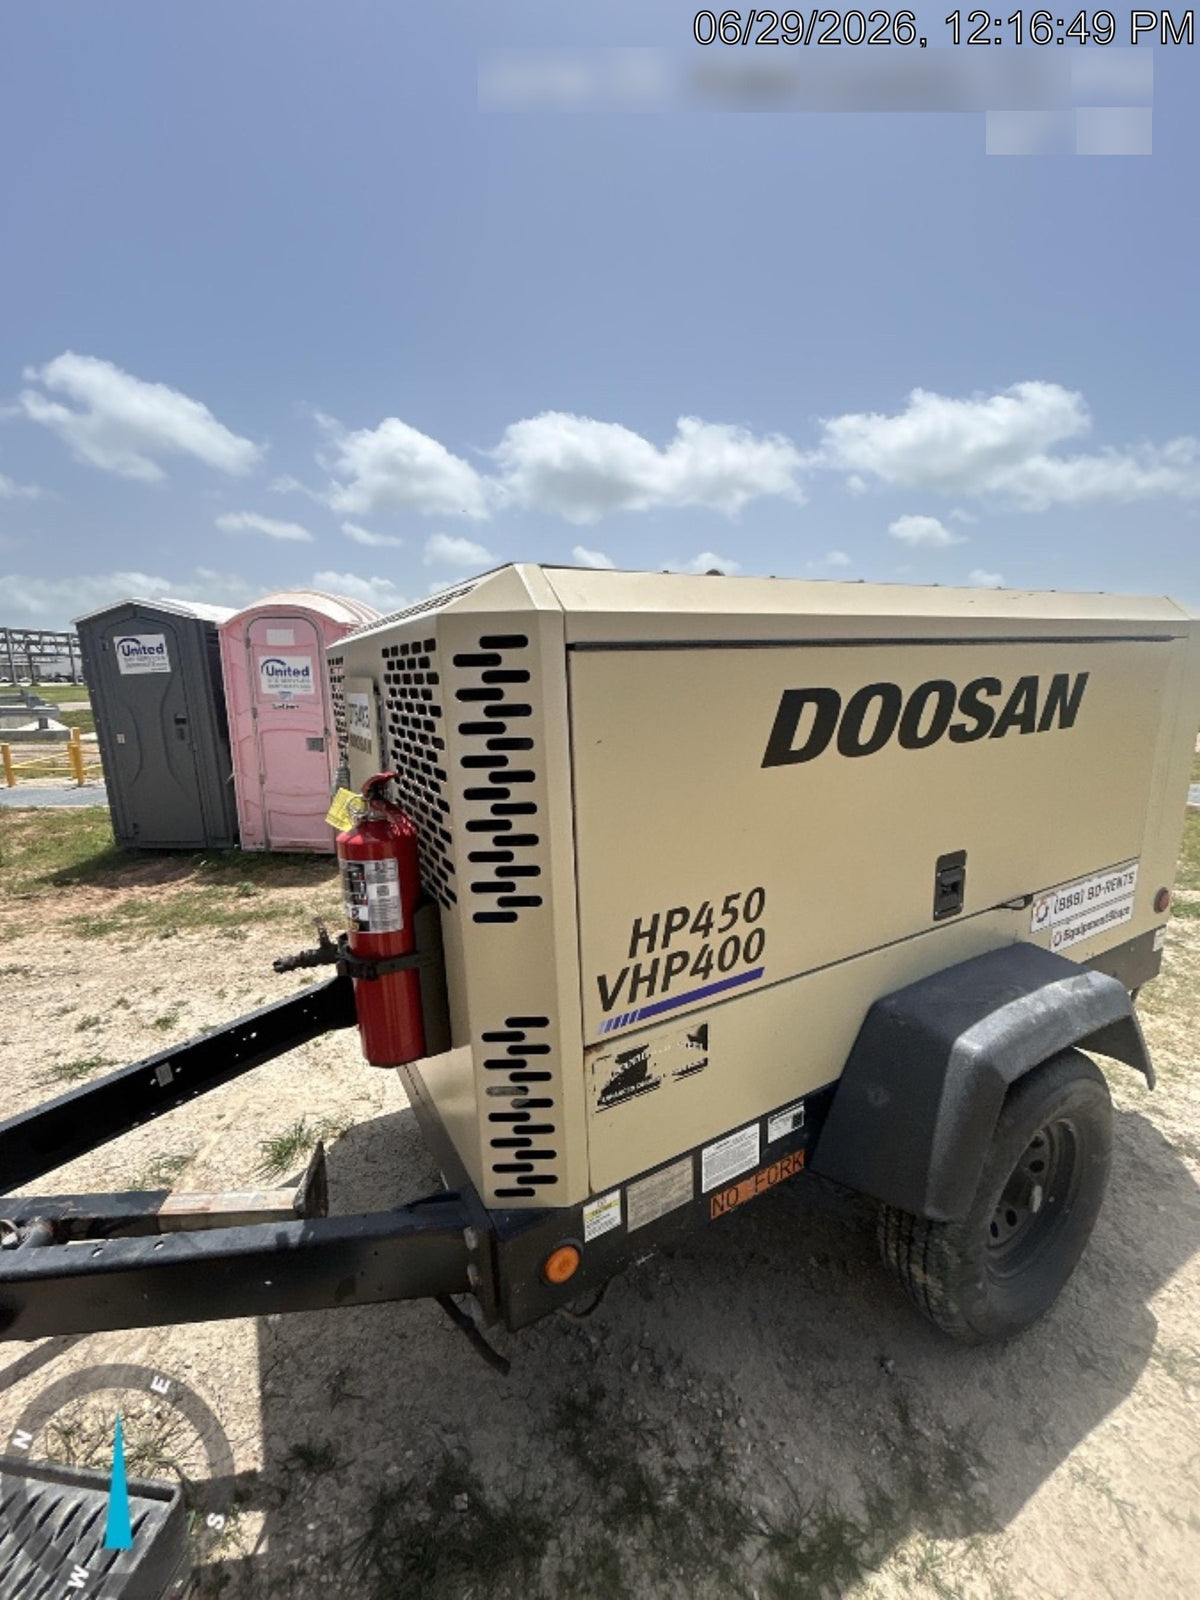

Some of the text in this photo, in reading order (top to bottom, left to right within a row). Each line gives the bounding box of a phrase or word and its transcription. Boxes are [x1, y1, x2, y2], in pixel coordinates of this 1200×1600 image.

[121, 643, 164, 656] United
[266, 664, 310, 677] United
[760, 672, 1090, 768] DOOSAN
[628, 886, 766, 959] HP450
[596, 927, 766, 1012] VHP400
[713, 1187, 739, 1217] NO
[755, 1151, 804, 1193] FORK
